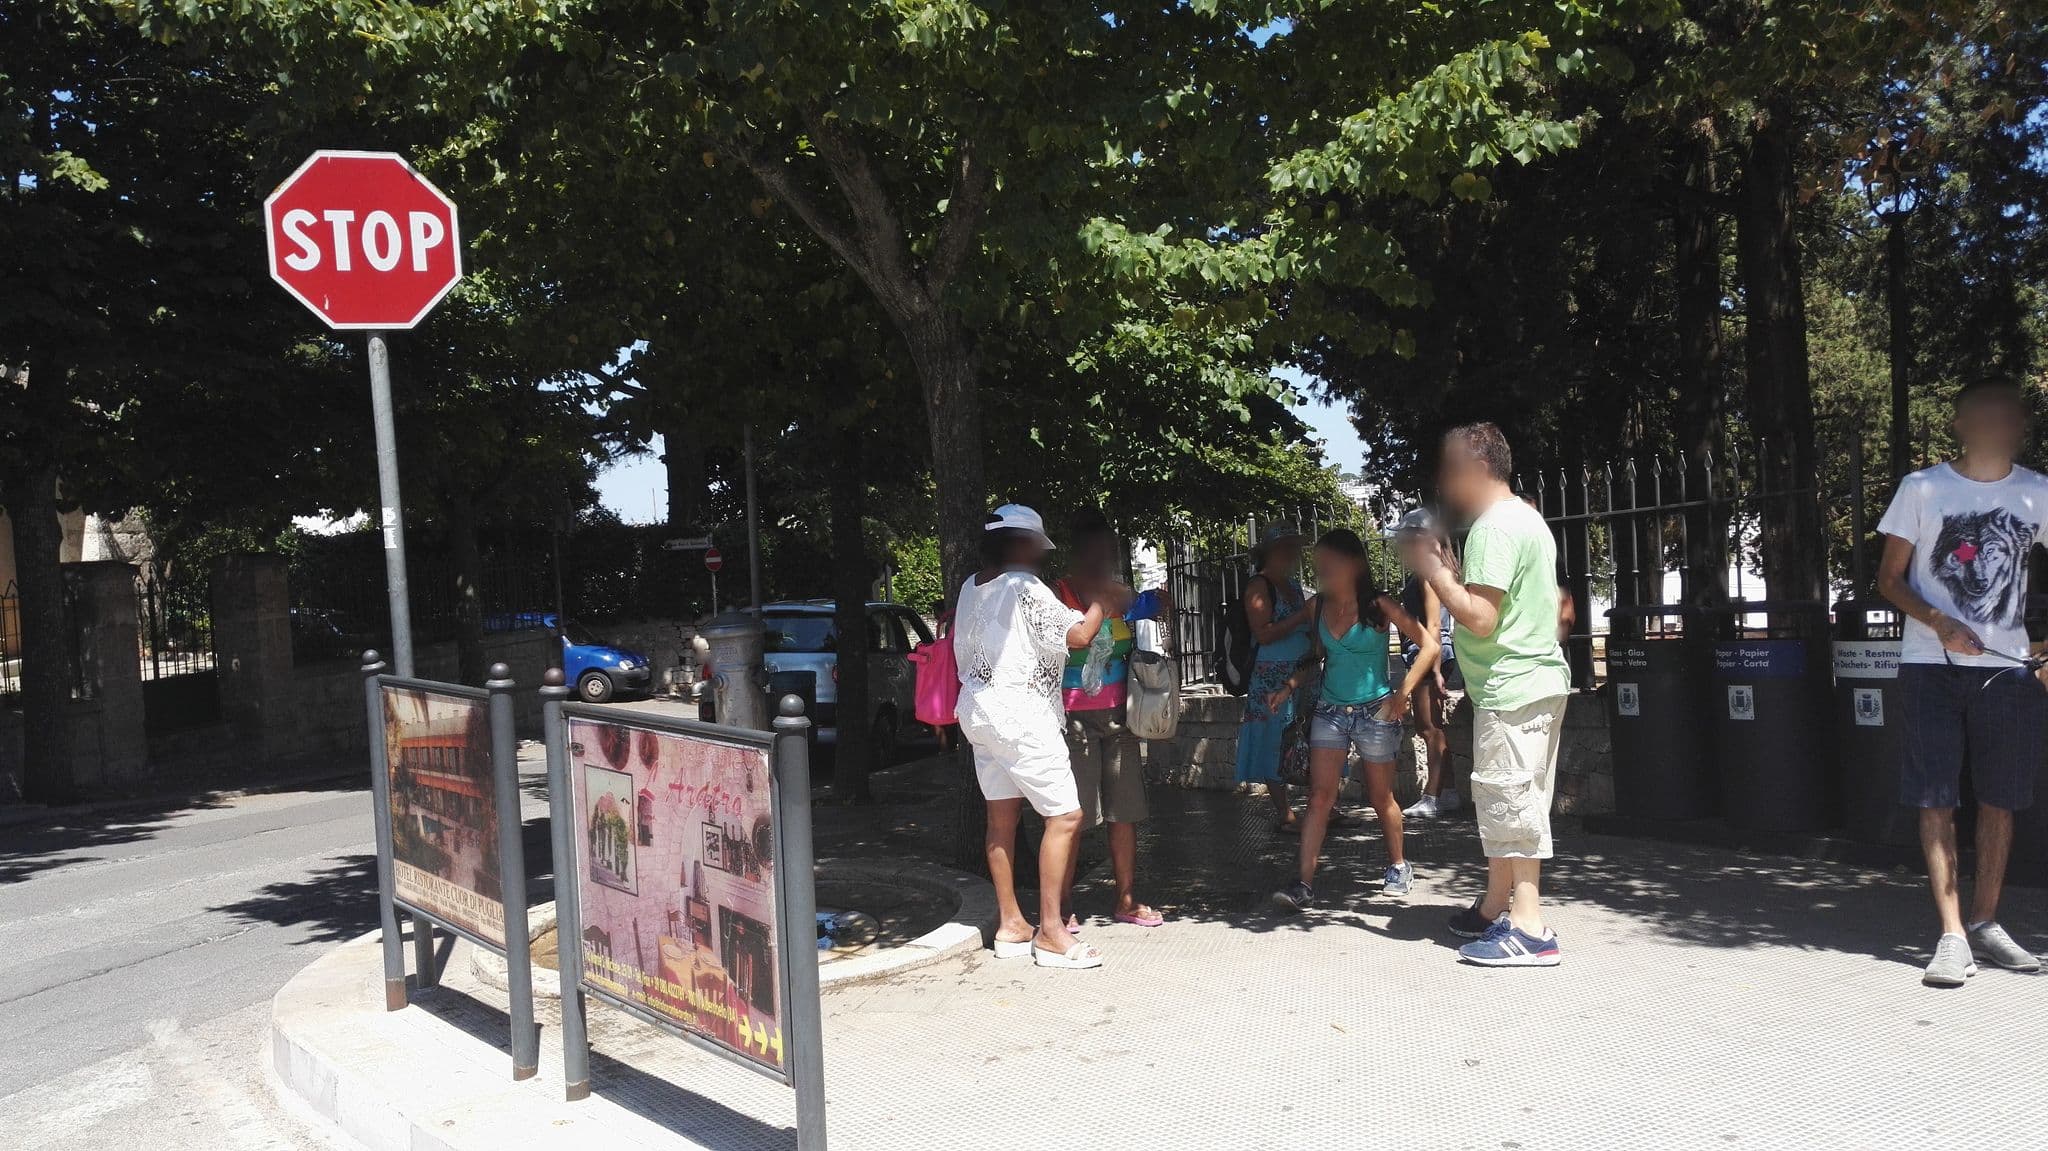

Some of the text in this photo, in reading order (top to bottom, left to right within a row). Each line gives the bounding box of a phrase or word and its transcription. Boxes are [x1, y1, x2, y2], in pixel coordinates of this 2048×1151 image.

[281, 208, 445, 272] STOP
[1627, 648, 1645, 657] Glas
[1739, 648, 1770, 659] Papier
[1628, 659, 1648, 667] Vetro
[1743, 659, 1770, 668] Carta
[395, 862, 414, 883] HOTEL
[414, 870, 451, 899] RISTORANTE
[451, 884, 469, 909] CUOR
[469, 893, 478, 913] DI
[478, 897, 505, 923] PUGLIA
